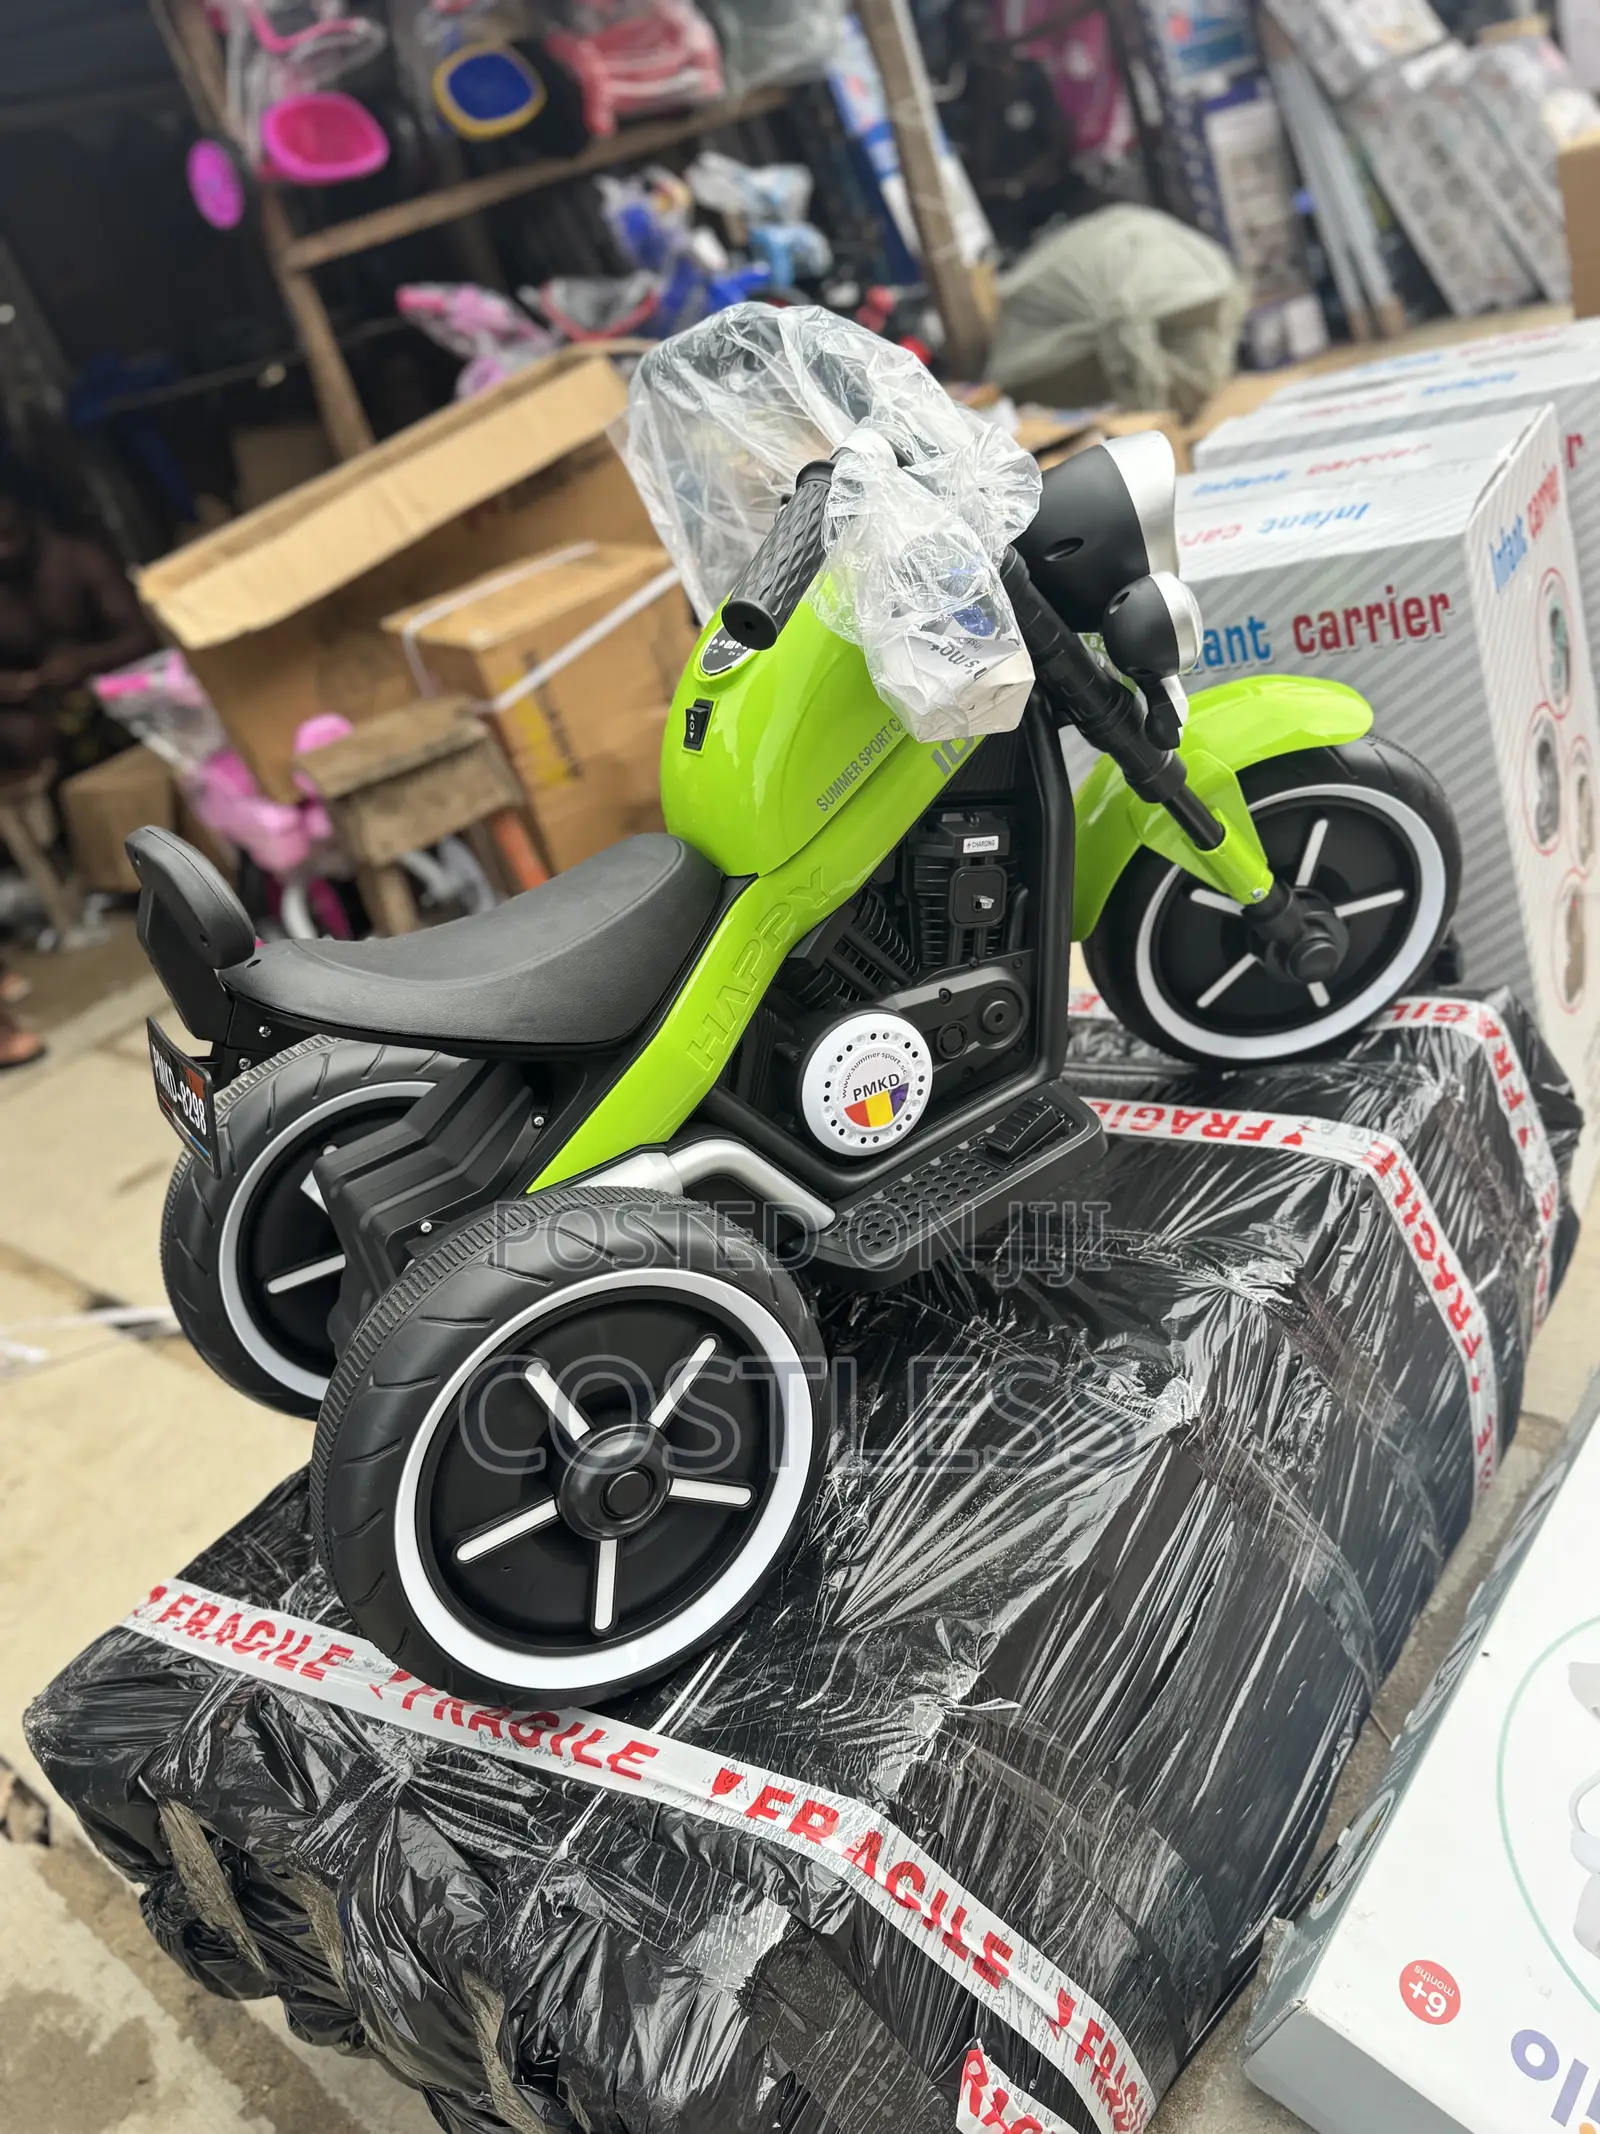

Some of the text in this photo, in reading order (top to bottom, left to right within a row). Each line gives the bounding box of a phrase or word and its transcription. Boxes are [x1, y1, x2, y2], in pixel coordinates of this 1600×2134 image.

[1193, 585, 1451, 669] ant carrier
[816, 760, 866, 812] SUMMER
[858, 725, 893, 768] SPORT
[686, 866, 829, 1072] HAPPY
[150, 1042, 207, 1136] PMKD-8298
[853, 1073, 900, 1102] PMKD
[159, 1595, 353, 1682] FRAGILE
[400, 1680, 660, 1781] FRAGILE
[744, 1785, 1014, 1991] FRAGILE
[1408, 1980, 1447, 2019] 6+
[1414, 1964, 1455, 1998] months
